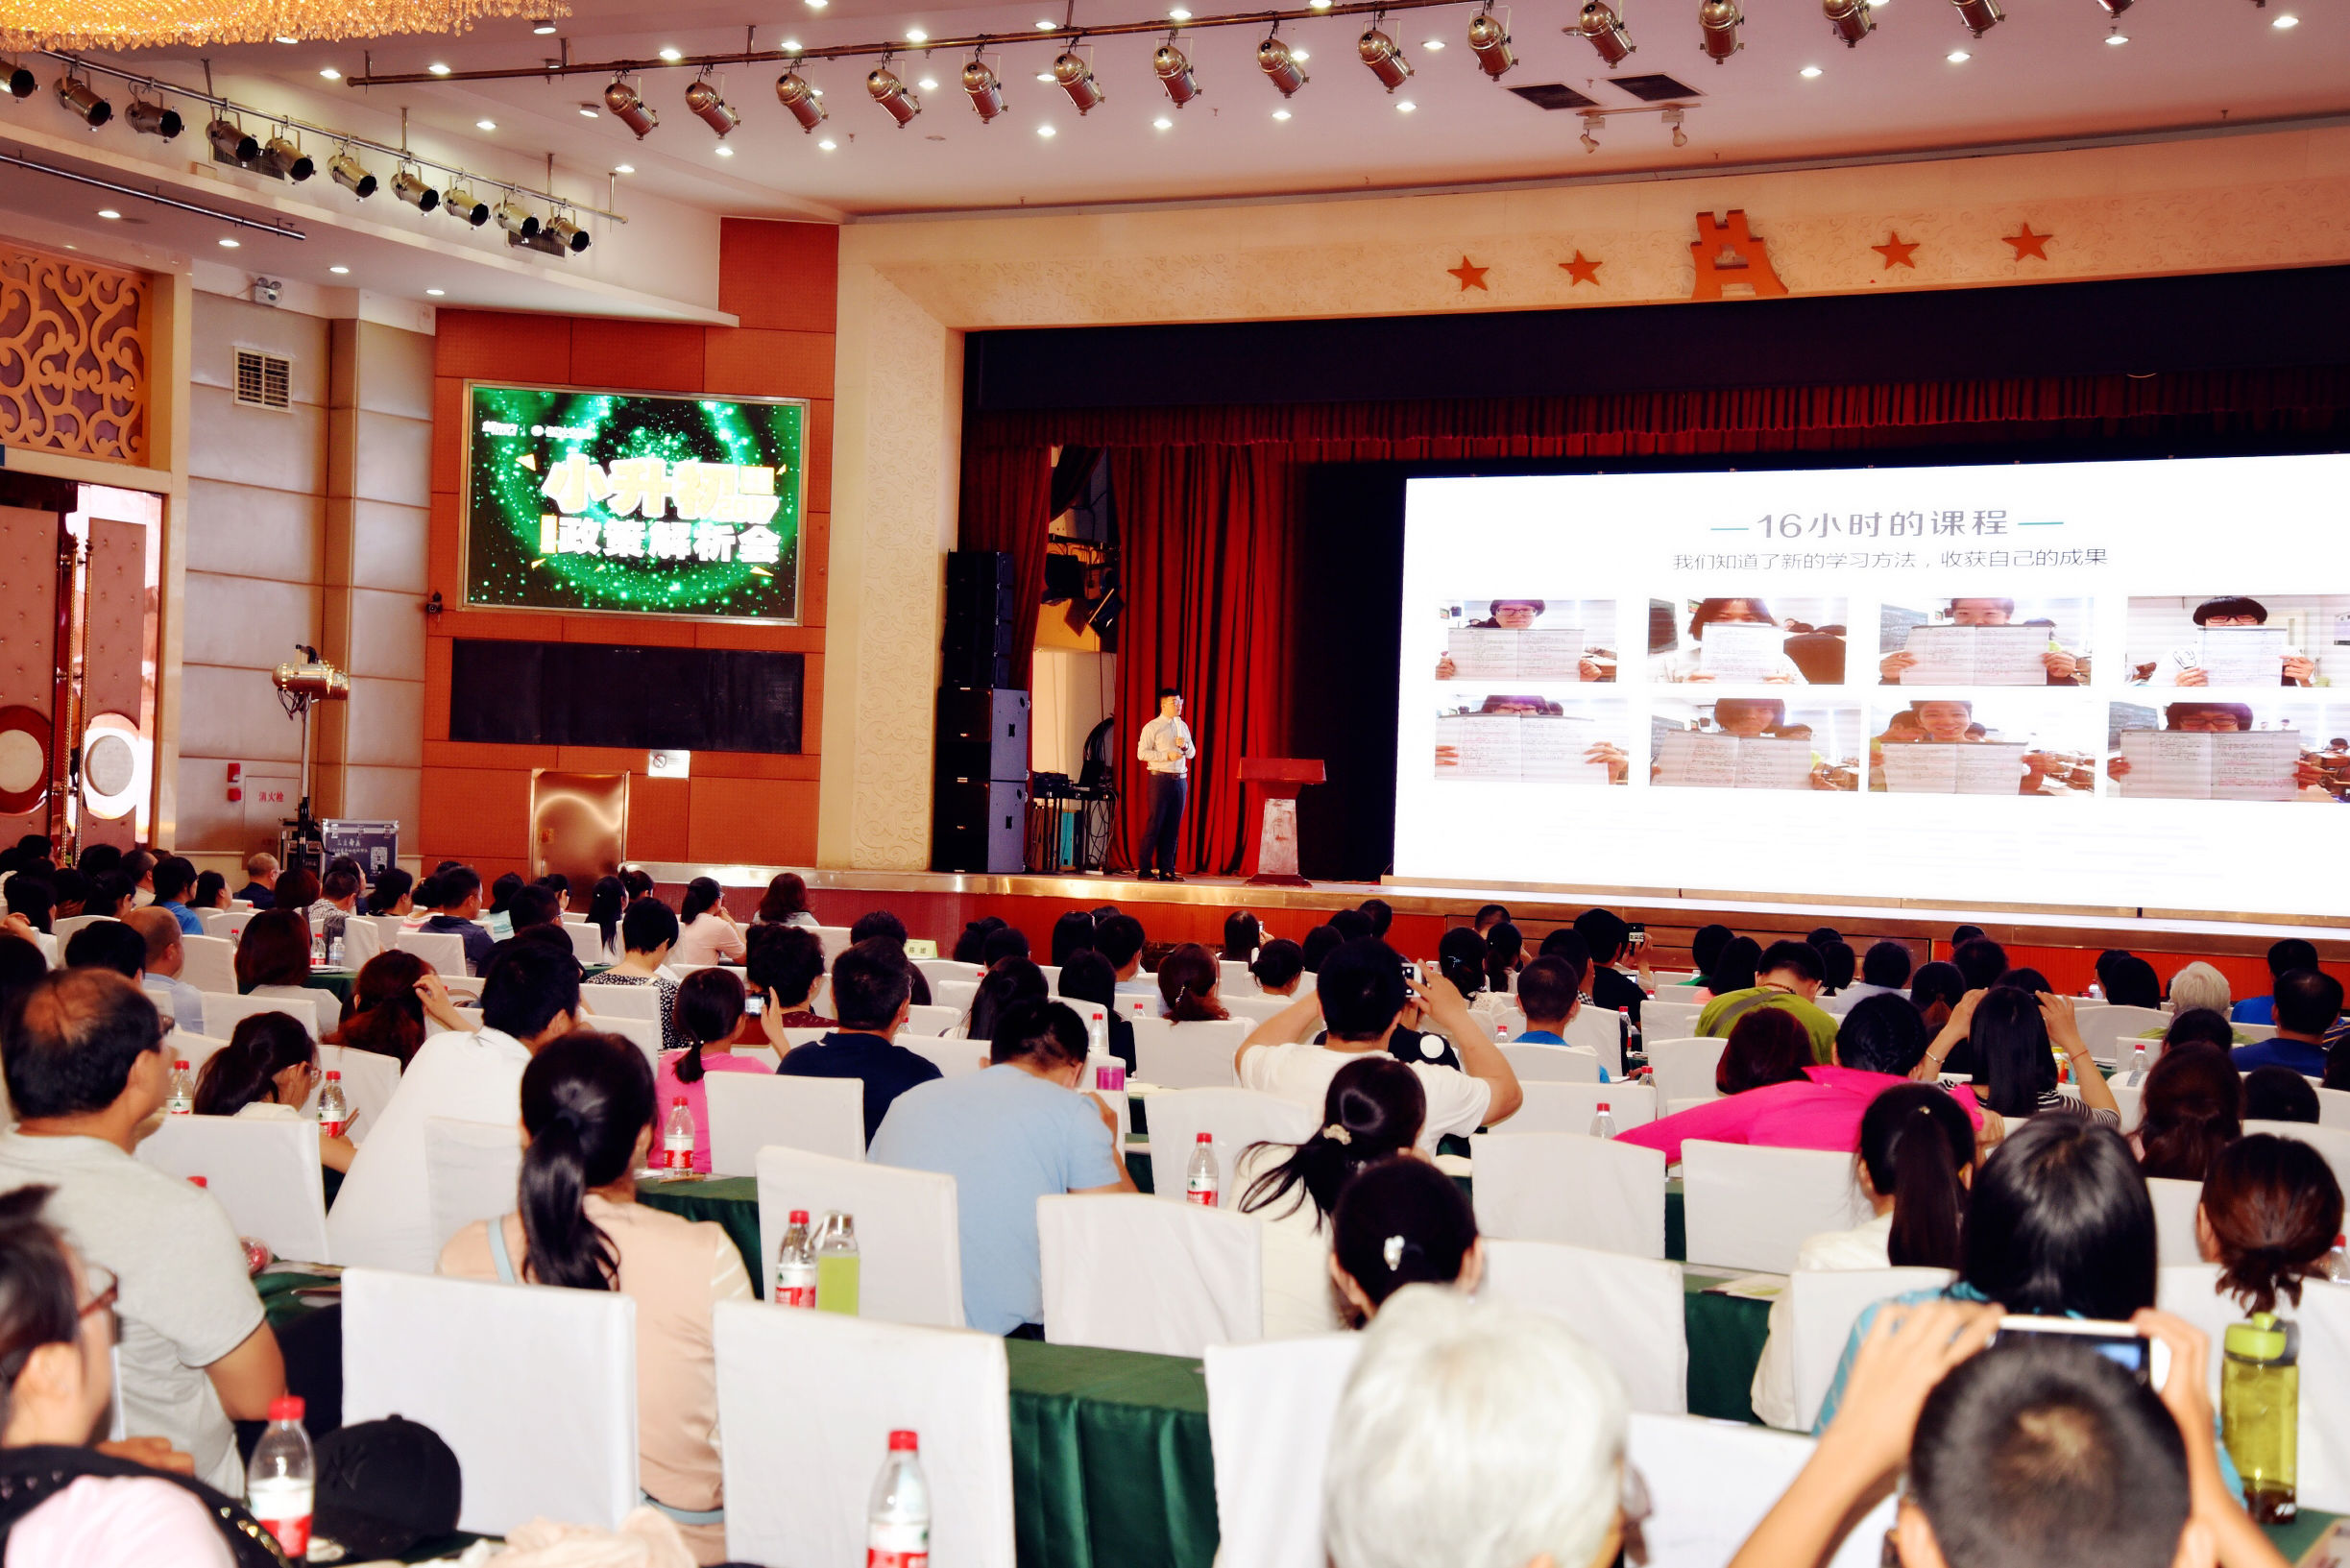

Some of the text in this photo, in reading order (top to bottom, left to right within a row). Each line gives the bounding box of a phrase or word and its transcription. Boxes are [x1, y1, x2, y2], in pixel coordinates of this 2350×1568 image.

[544, 455, 739, 519] 小升初
[558, 517, 782, 564] 政策解析会
[1756, 509, 2008, 539] 16小时的课程
